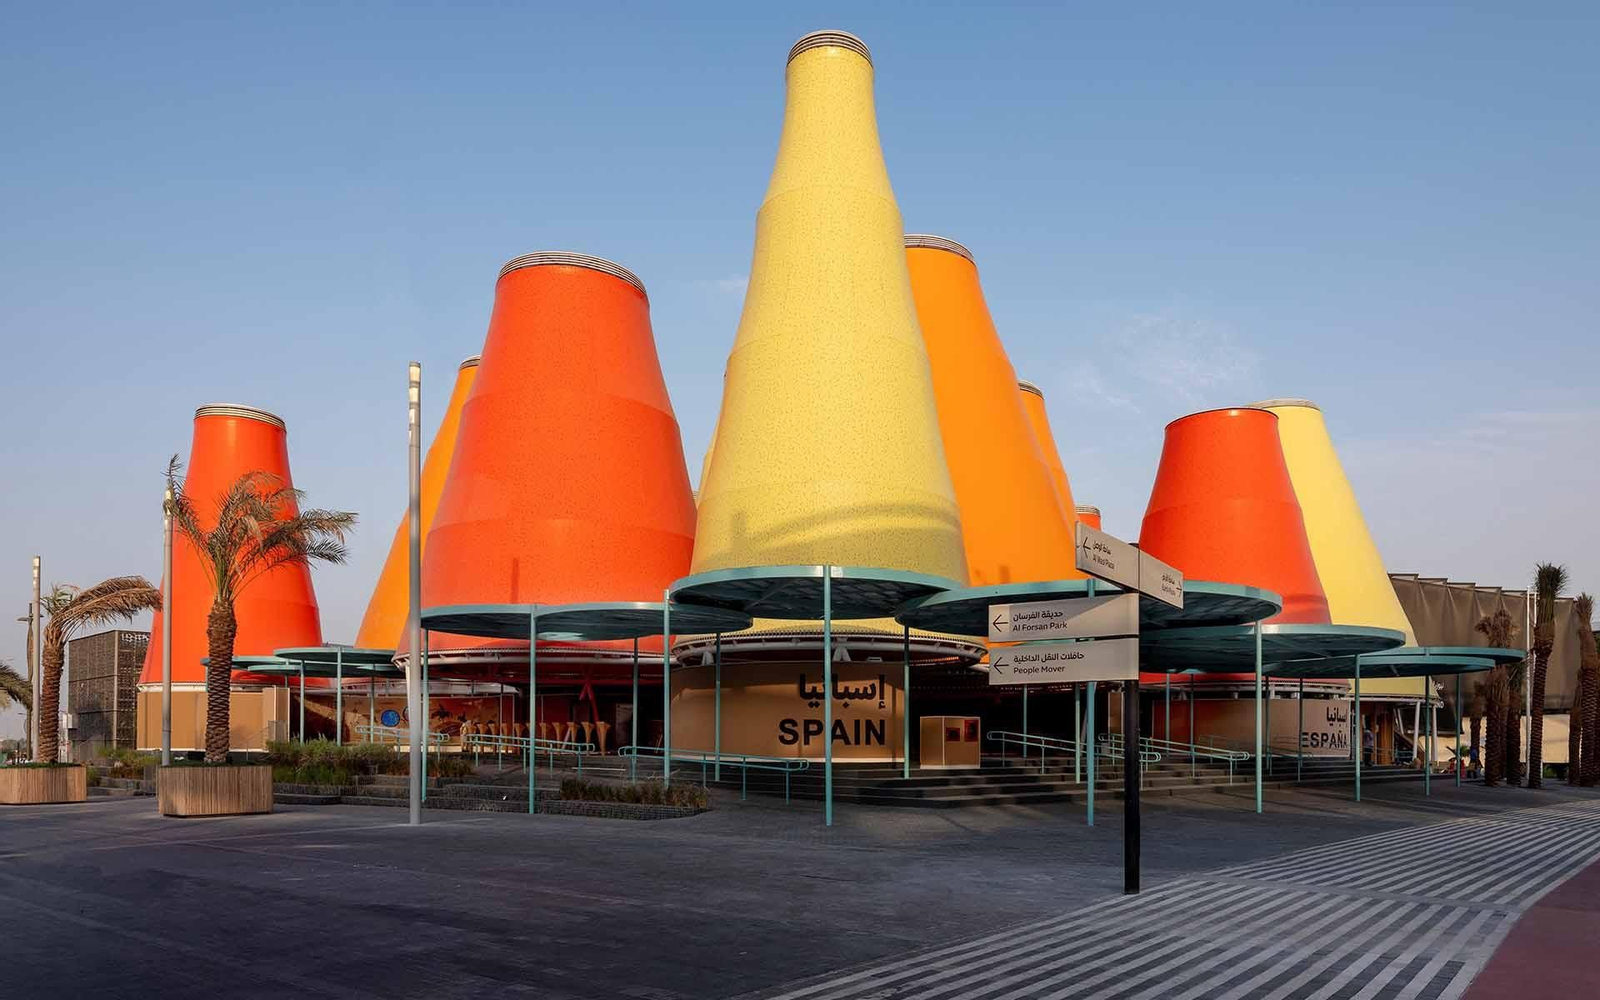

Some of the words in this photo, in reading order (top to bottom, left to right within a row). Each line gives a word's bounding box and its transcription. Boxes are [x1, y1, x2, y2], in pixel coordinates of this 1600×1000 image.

[1013, 611, 1040, 622] الفرسان
[1041, 610, 1064, 620] حديقة
[1013, 624, 1021, 632] Al
[1022, 623, 1048, 631] Forsan
[1050, 621, 1068, 629] Park
[1013, 654, 1040, 665] الداخلية
[1041, 653, 1059, 663] النقل
[1060, 651, 1085, 661] حافلات
[1013, 666, 1040, 675] People
[778, 718, 886, 746] SPAIN
